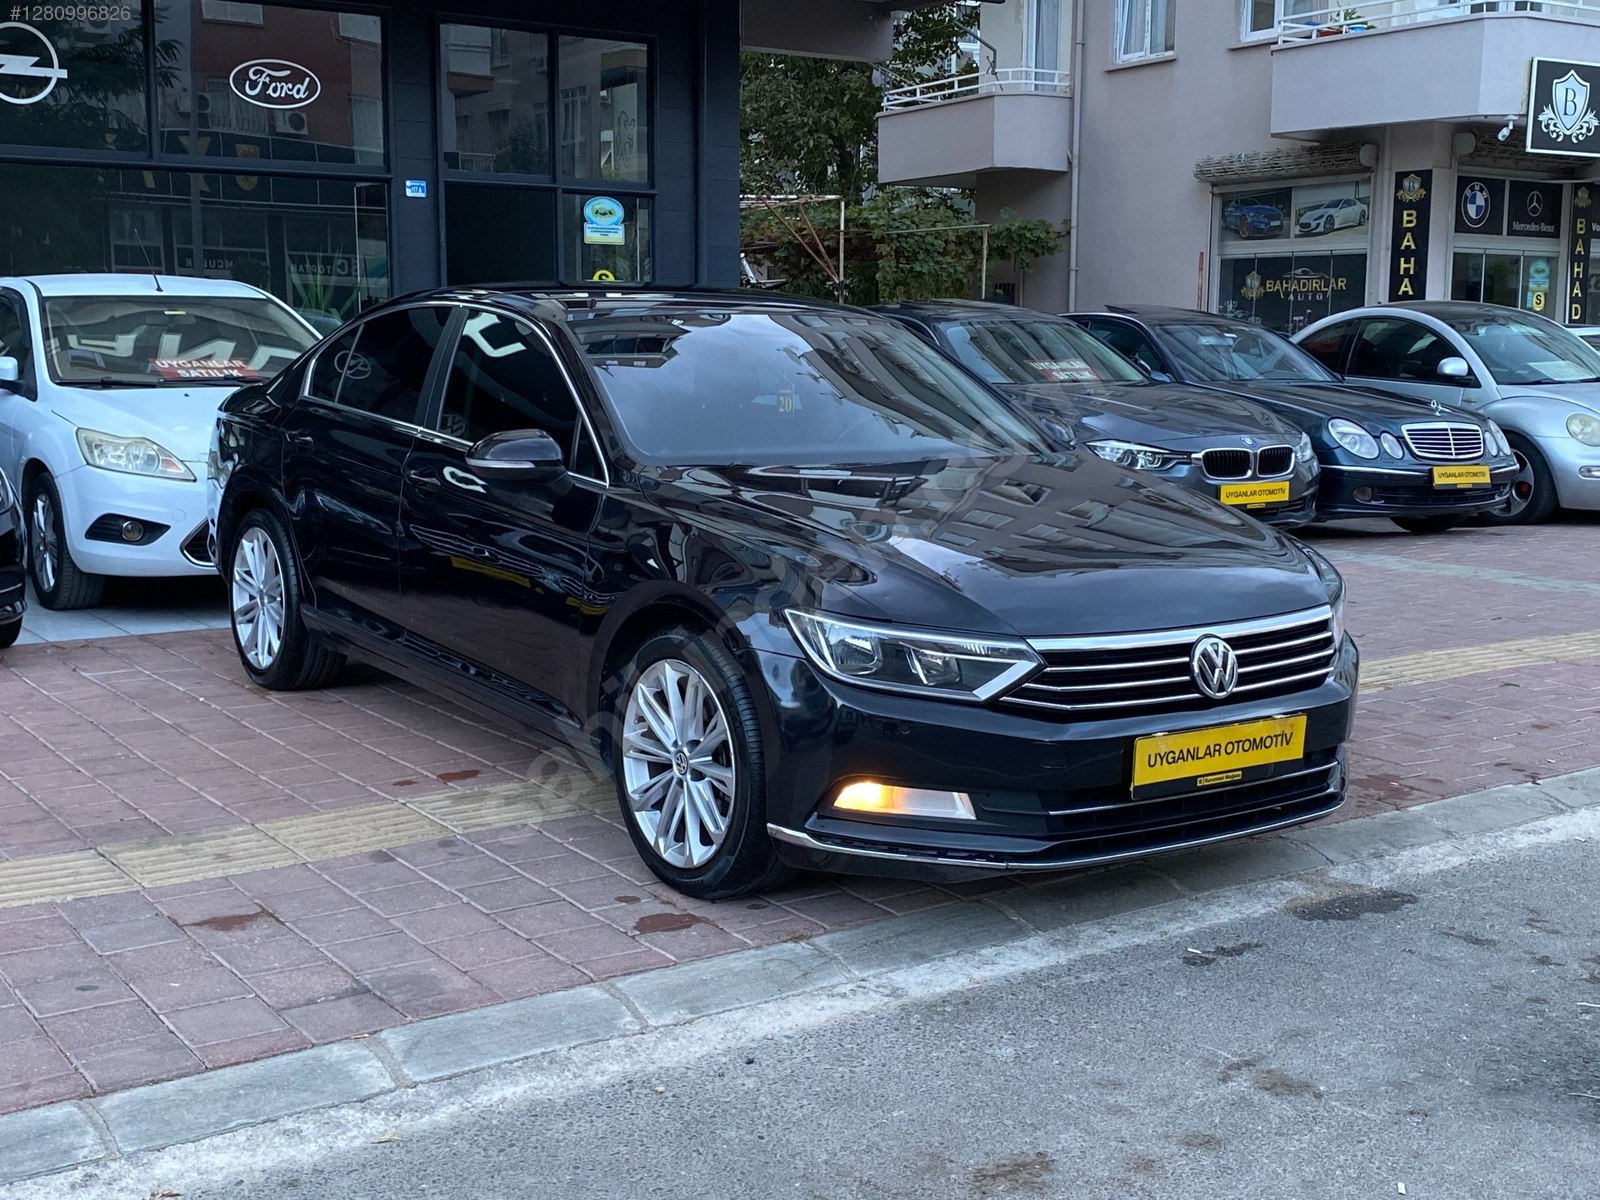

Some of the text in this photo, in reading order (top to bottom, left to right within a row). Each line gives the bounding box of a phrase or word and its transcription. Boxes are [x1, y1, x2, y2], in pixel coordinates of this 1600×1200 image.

[245, 65, 310, 99] Ford
[1563, 87, 1577, 117] B
[1512, 221, 1555, 233] Mercedes-Benz
[1266, 277, 1347, 299] BAHADIRLAR
[1288, 292, 1323, 301] AUTO
[1535, 293, 1543, 306] S
[155, 359, 248, 368] UYGANLAR
[177, 369, 244, 377] SATILIK
[779, 396, 792, 413] 20
[1225, 489, 1257, 499] UYGANLAR
[1147, 730, 1294, 768] UYGANLAR OTOMOTİV
